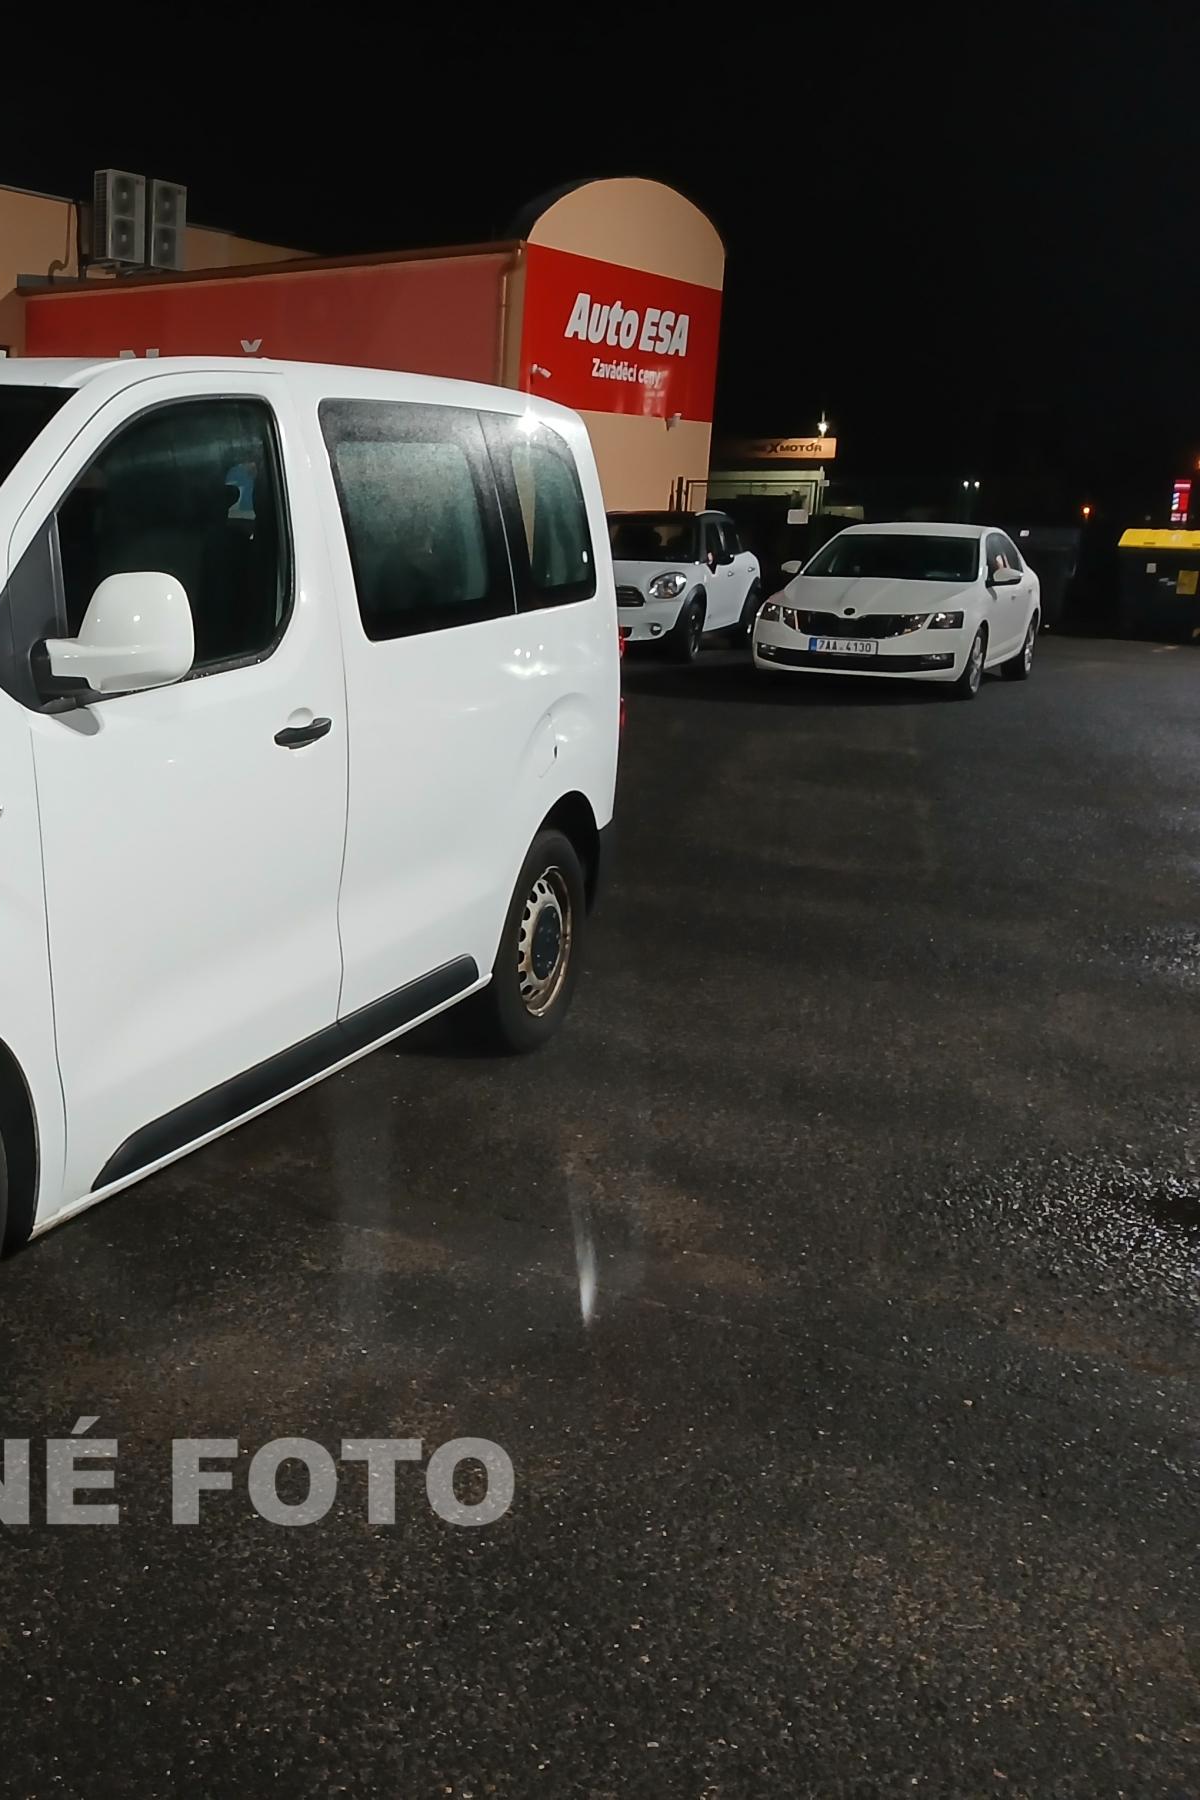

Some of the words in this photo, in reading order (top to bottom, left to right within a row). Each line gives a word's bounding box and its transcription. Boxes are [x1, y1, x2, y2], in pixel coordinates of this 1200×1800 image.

[564, 292, 640, 349] Auto
[638, 307, 690, 357] ESA
[591, 358, 638, 381] Zaváděcí
